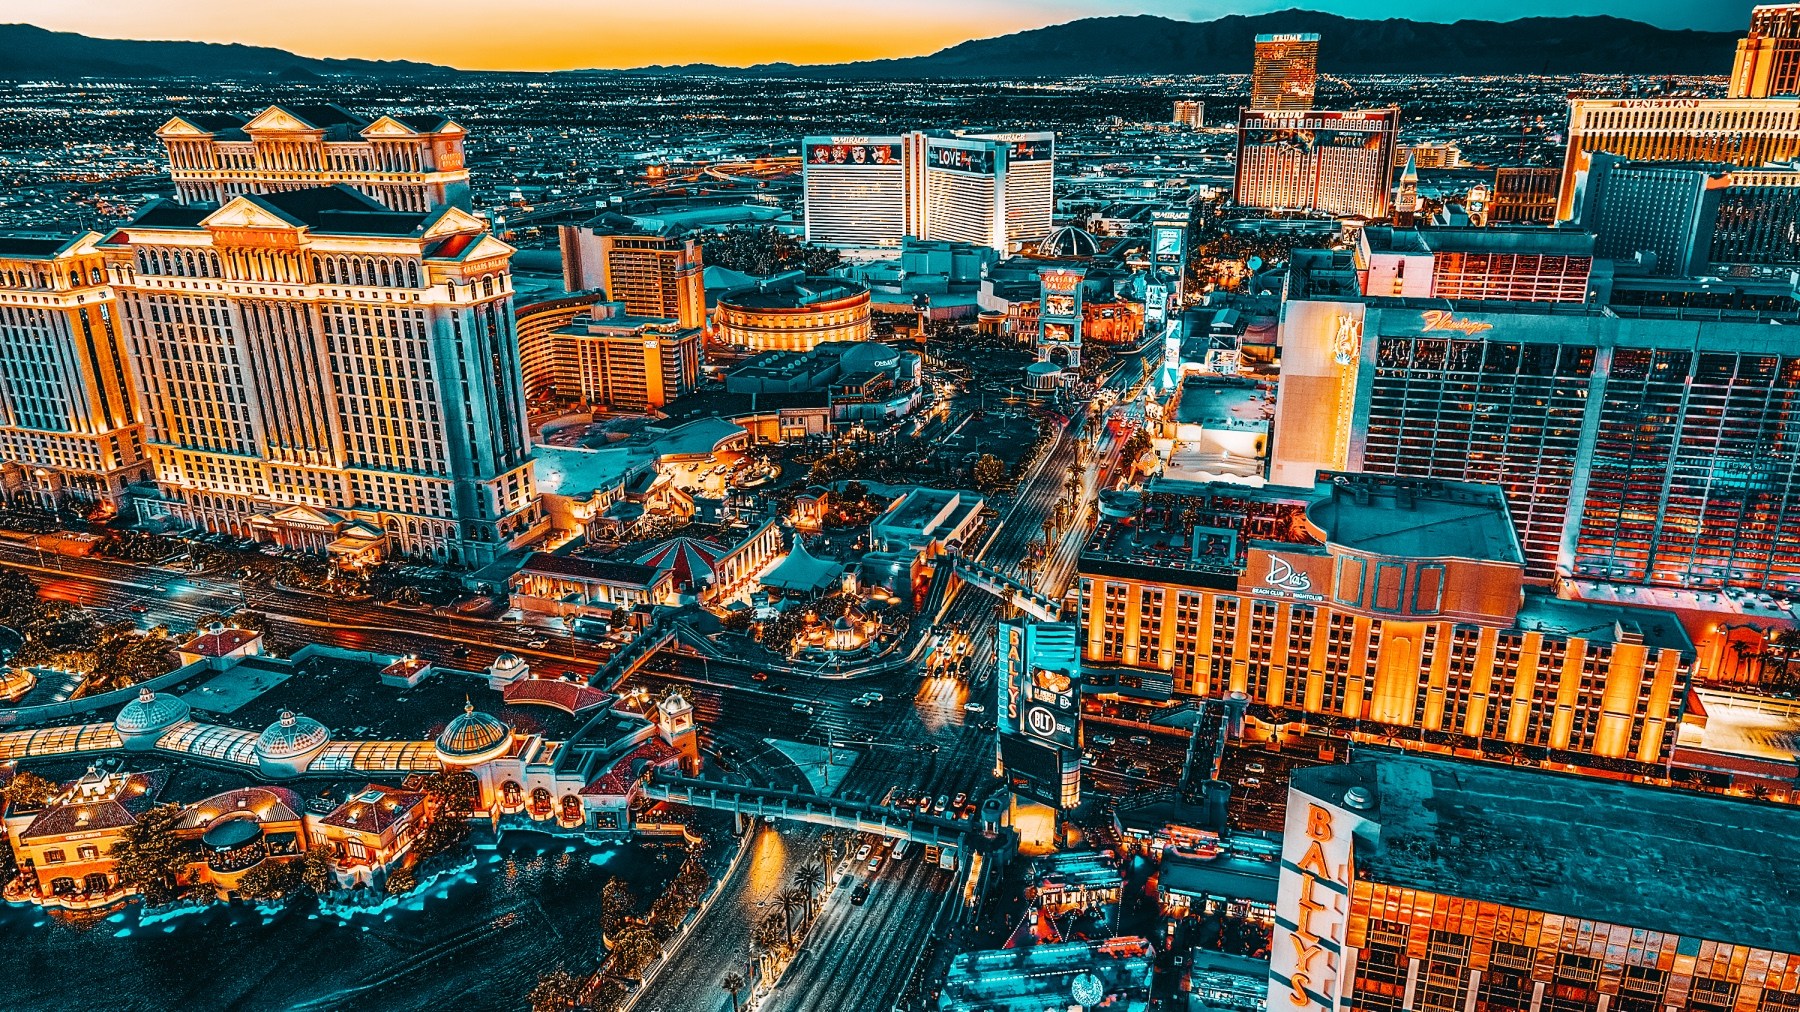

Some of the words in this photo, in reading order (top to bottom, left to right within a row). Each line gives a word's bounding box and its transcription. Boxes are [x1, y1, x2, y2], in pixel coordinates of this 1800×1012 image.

[1273, 34, 1302, 42] TRUMP
[1626, 100, 1696, 109] VENETIAN
[838, 136, 869, 144] MIRAGE
[939, 149, 961, 166] LOVE
[1159, 211, 1190, 220] MIRAGE
[1421, 310, 1494, 336] Flamingo
[1252, 587, 1270, 595] BEACH
[1270, 589, 1285, 597] CLUB
[1292, 592, 1323, 601] NIGHTCLUB
[1034, 711, 1051, 731] BLT
[1056, 723, 1072, 735] STEAK
